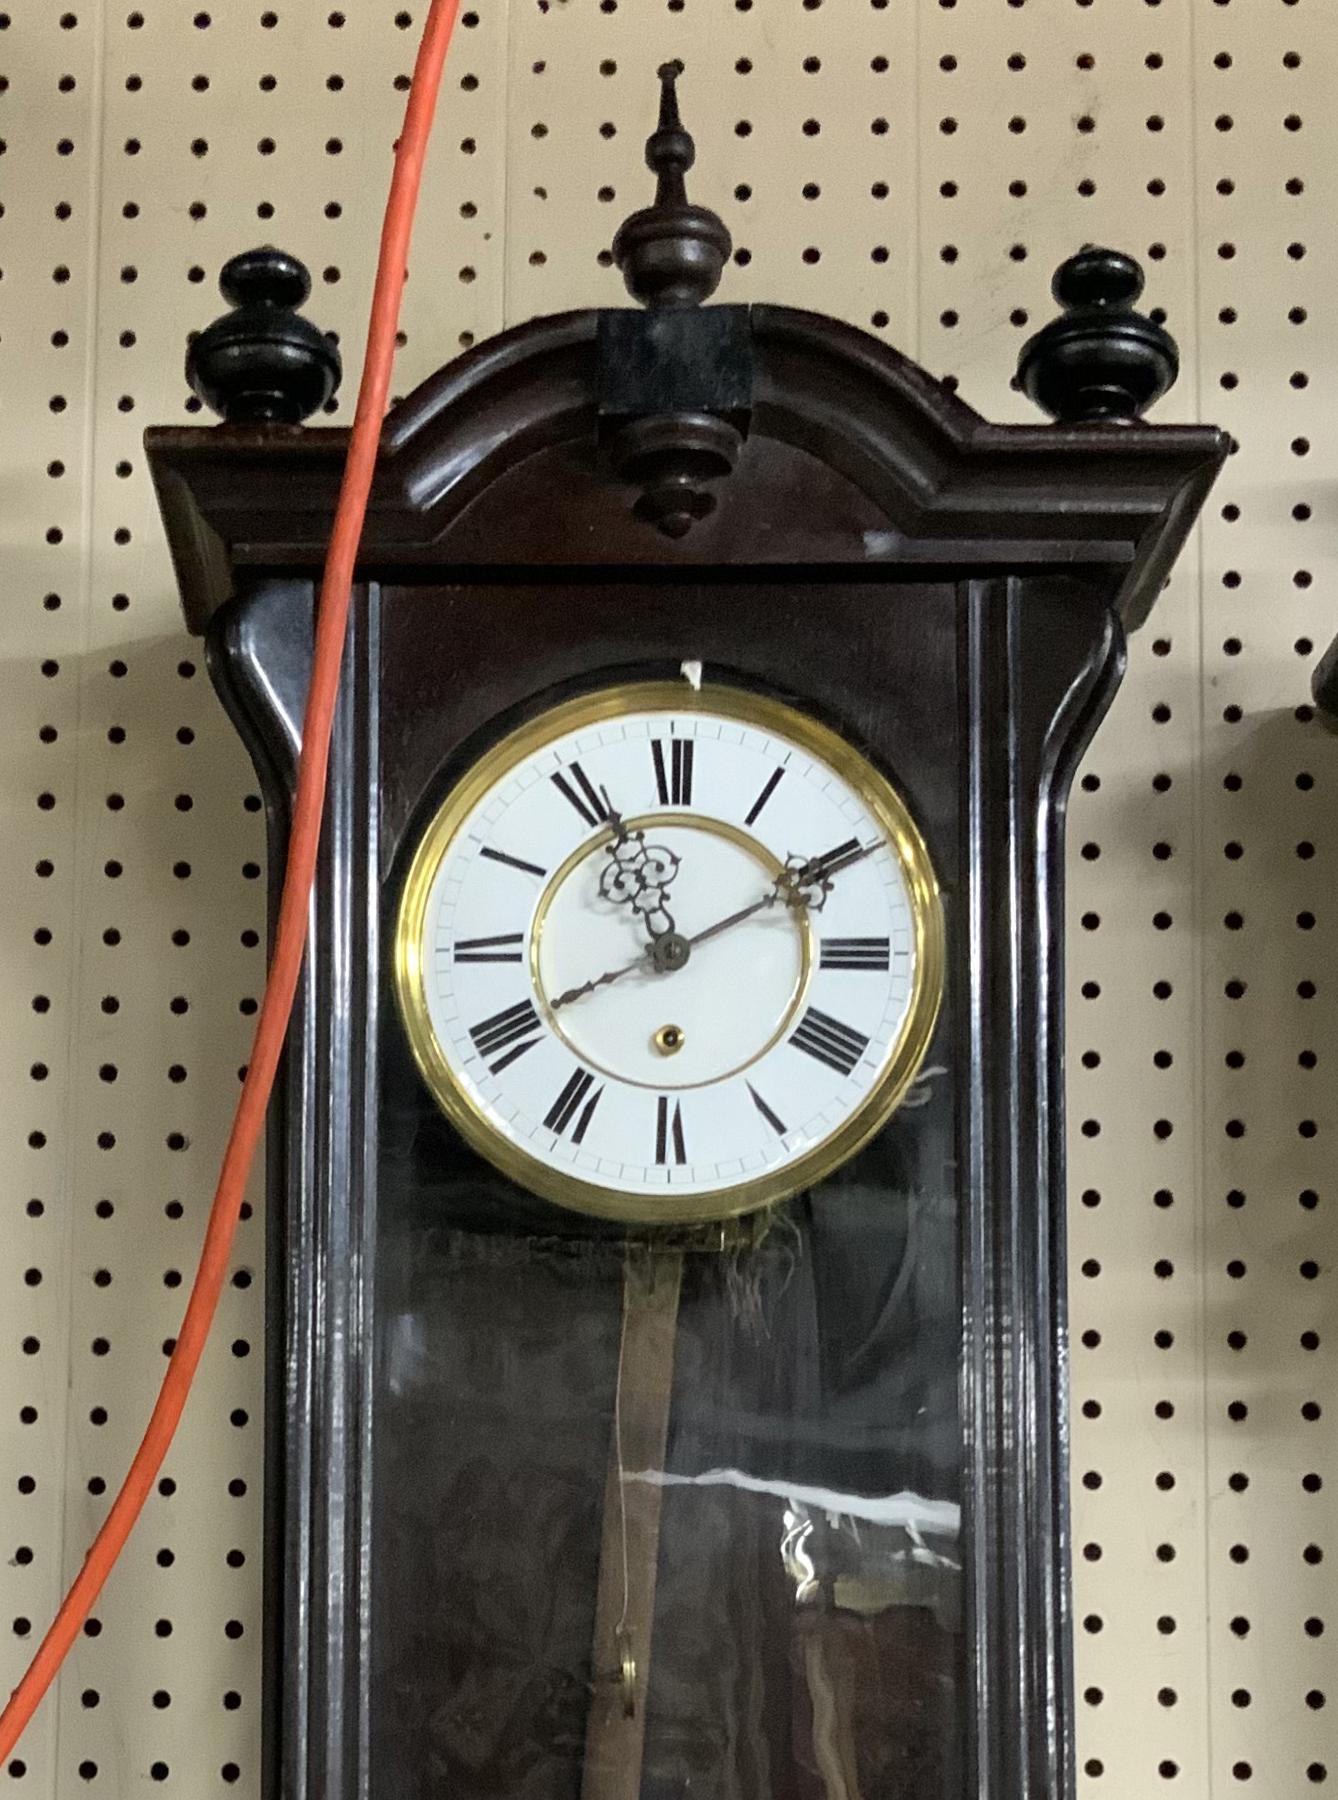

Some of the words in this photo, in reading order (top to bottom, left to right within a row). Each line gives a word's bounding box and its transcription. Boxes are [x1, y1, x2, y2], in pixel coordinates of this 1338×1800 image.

[649, 738, 694, 807] XII
[743, 766, 786, 827] I
[819, 937, 891, 972] III
